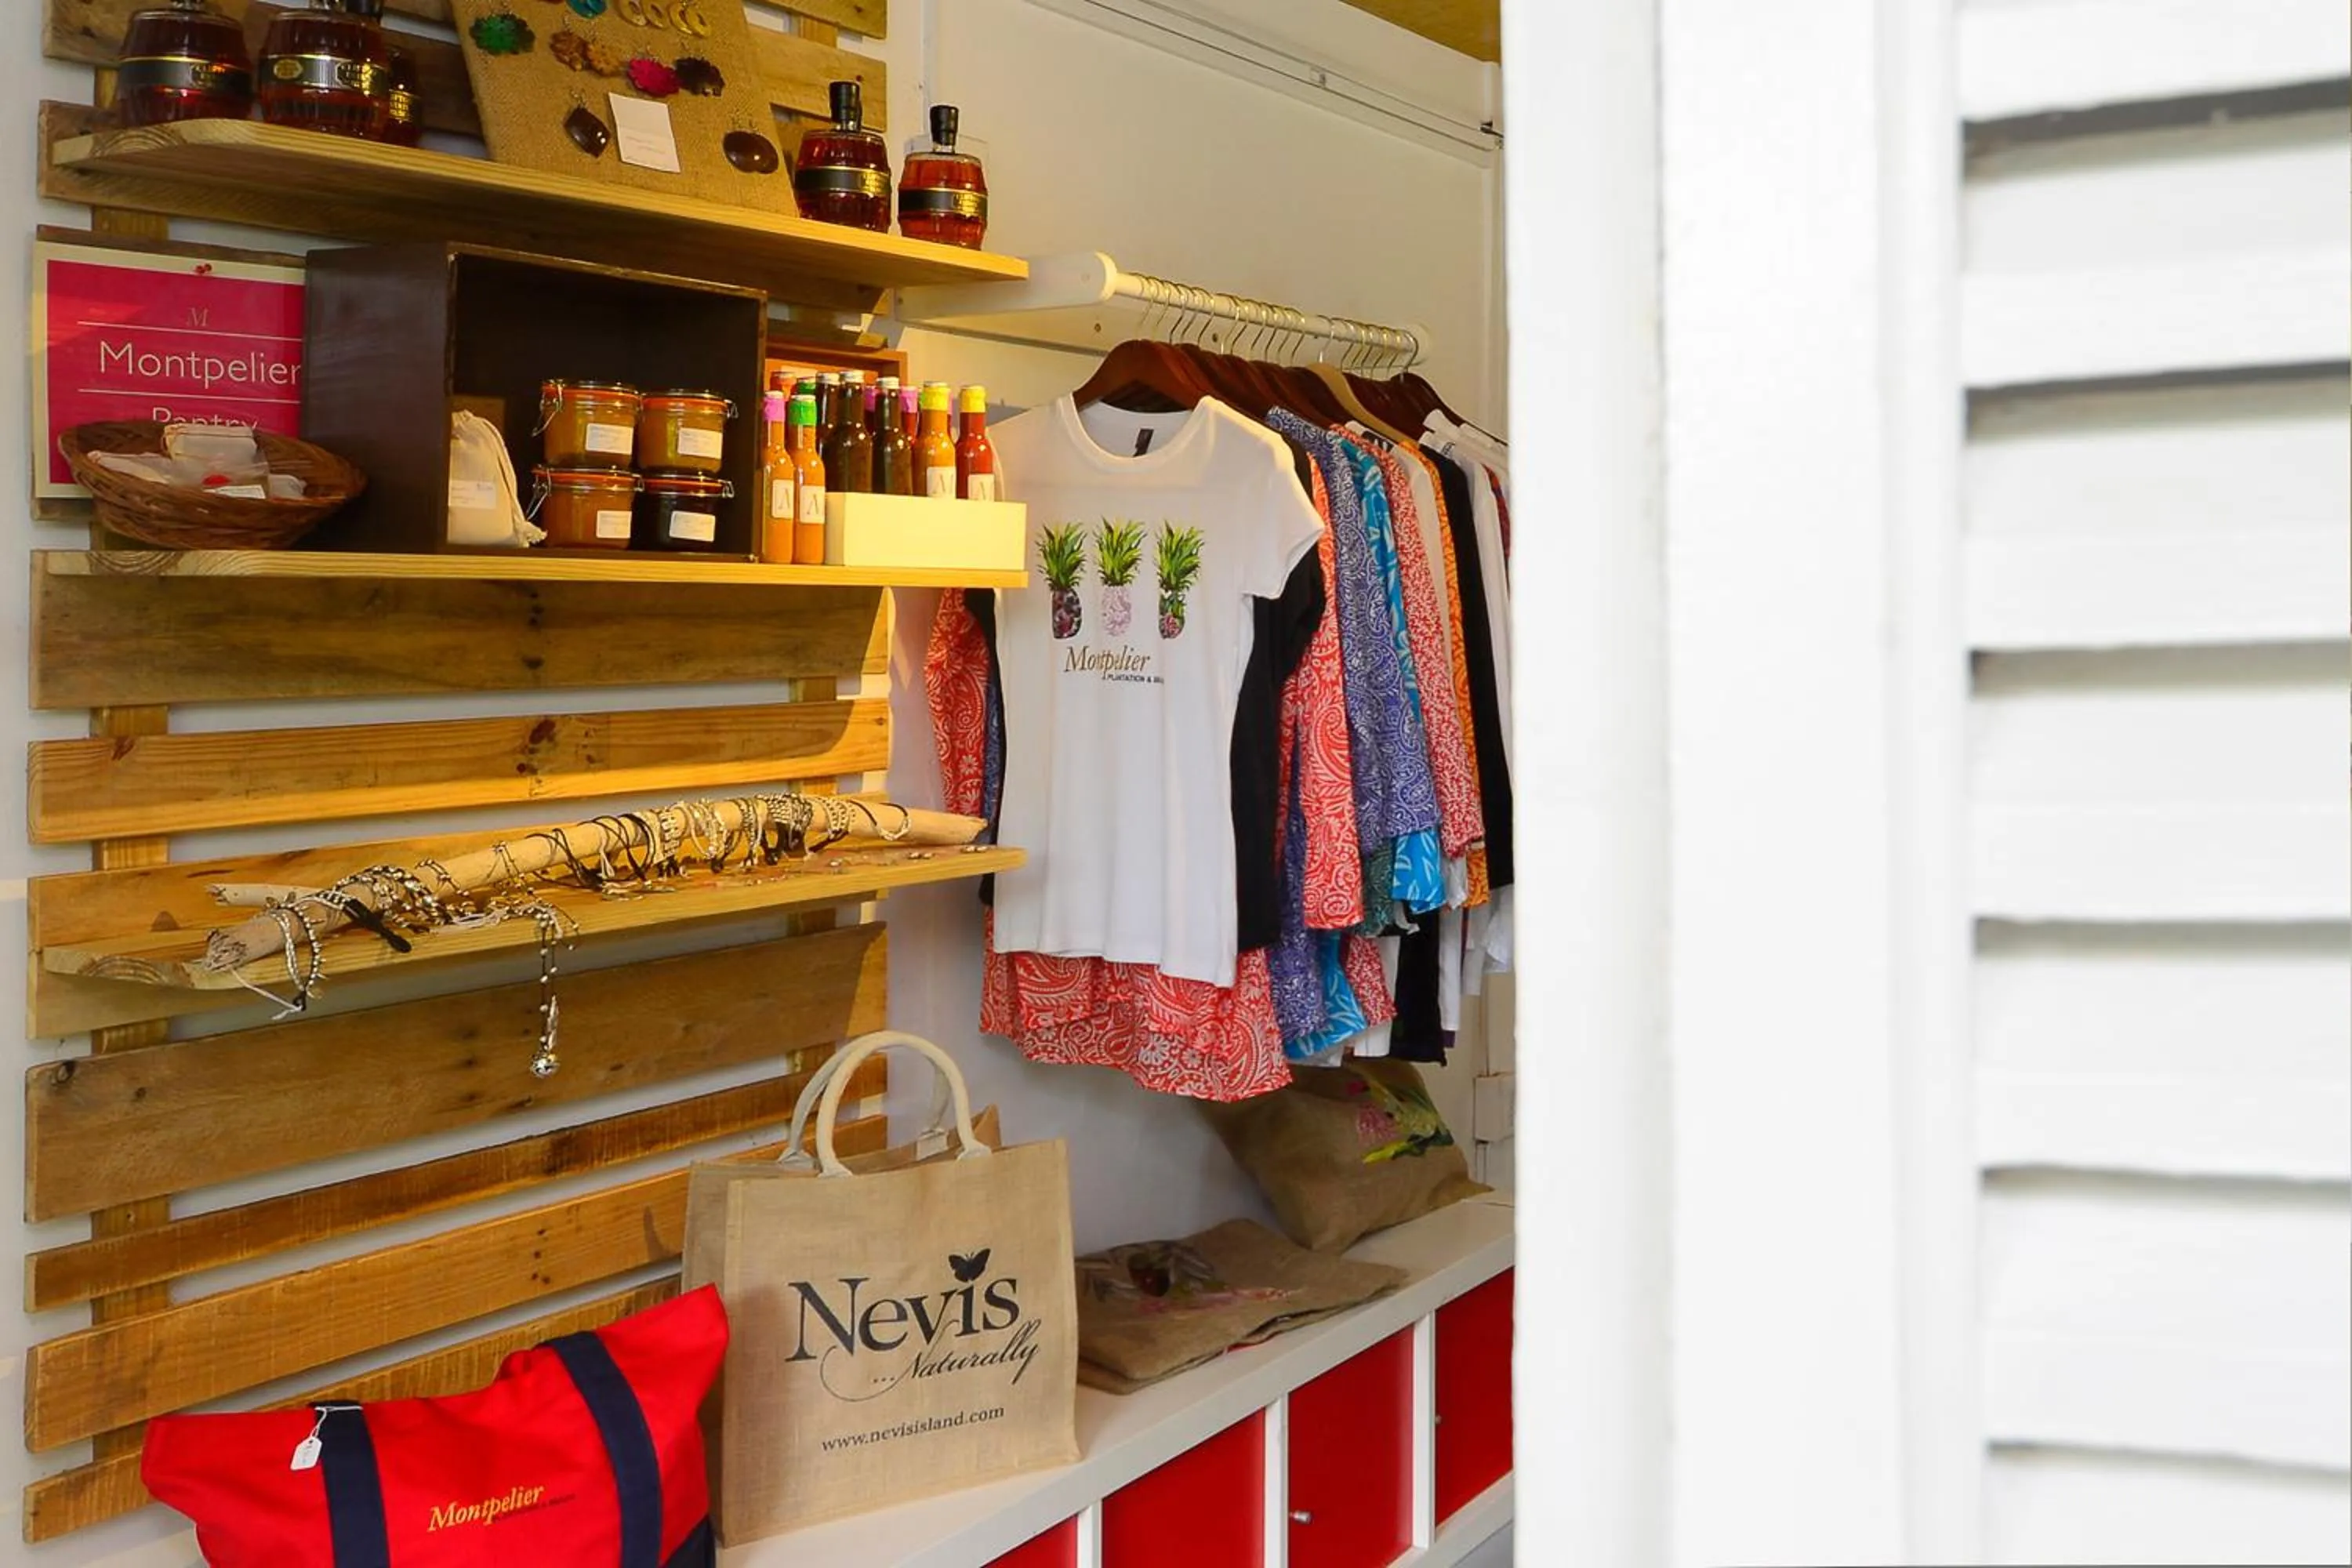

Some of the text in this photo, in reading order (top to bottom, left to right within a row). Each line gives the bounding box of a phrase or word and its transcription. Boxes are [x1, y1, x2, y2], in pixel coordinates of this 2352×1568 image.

[187, 308, 209, 327] M
[100, 340, 301, 389] Montpelier
[785, 1278, 1020, 1363] Nevis
[821, 1406, 1005, 1451] www.nevisisland.com
[426, 1486, 545, 1533] Montpelier
